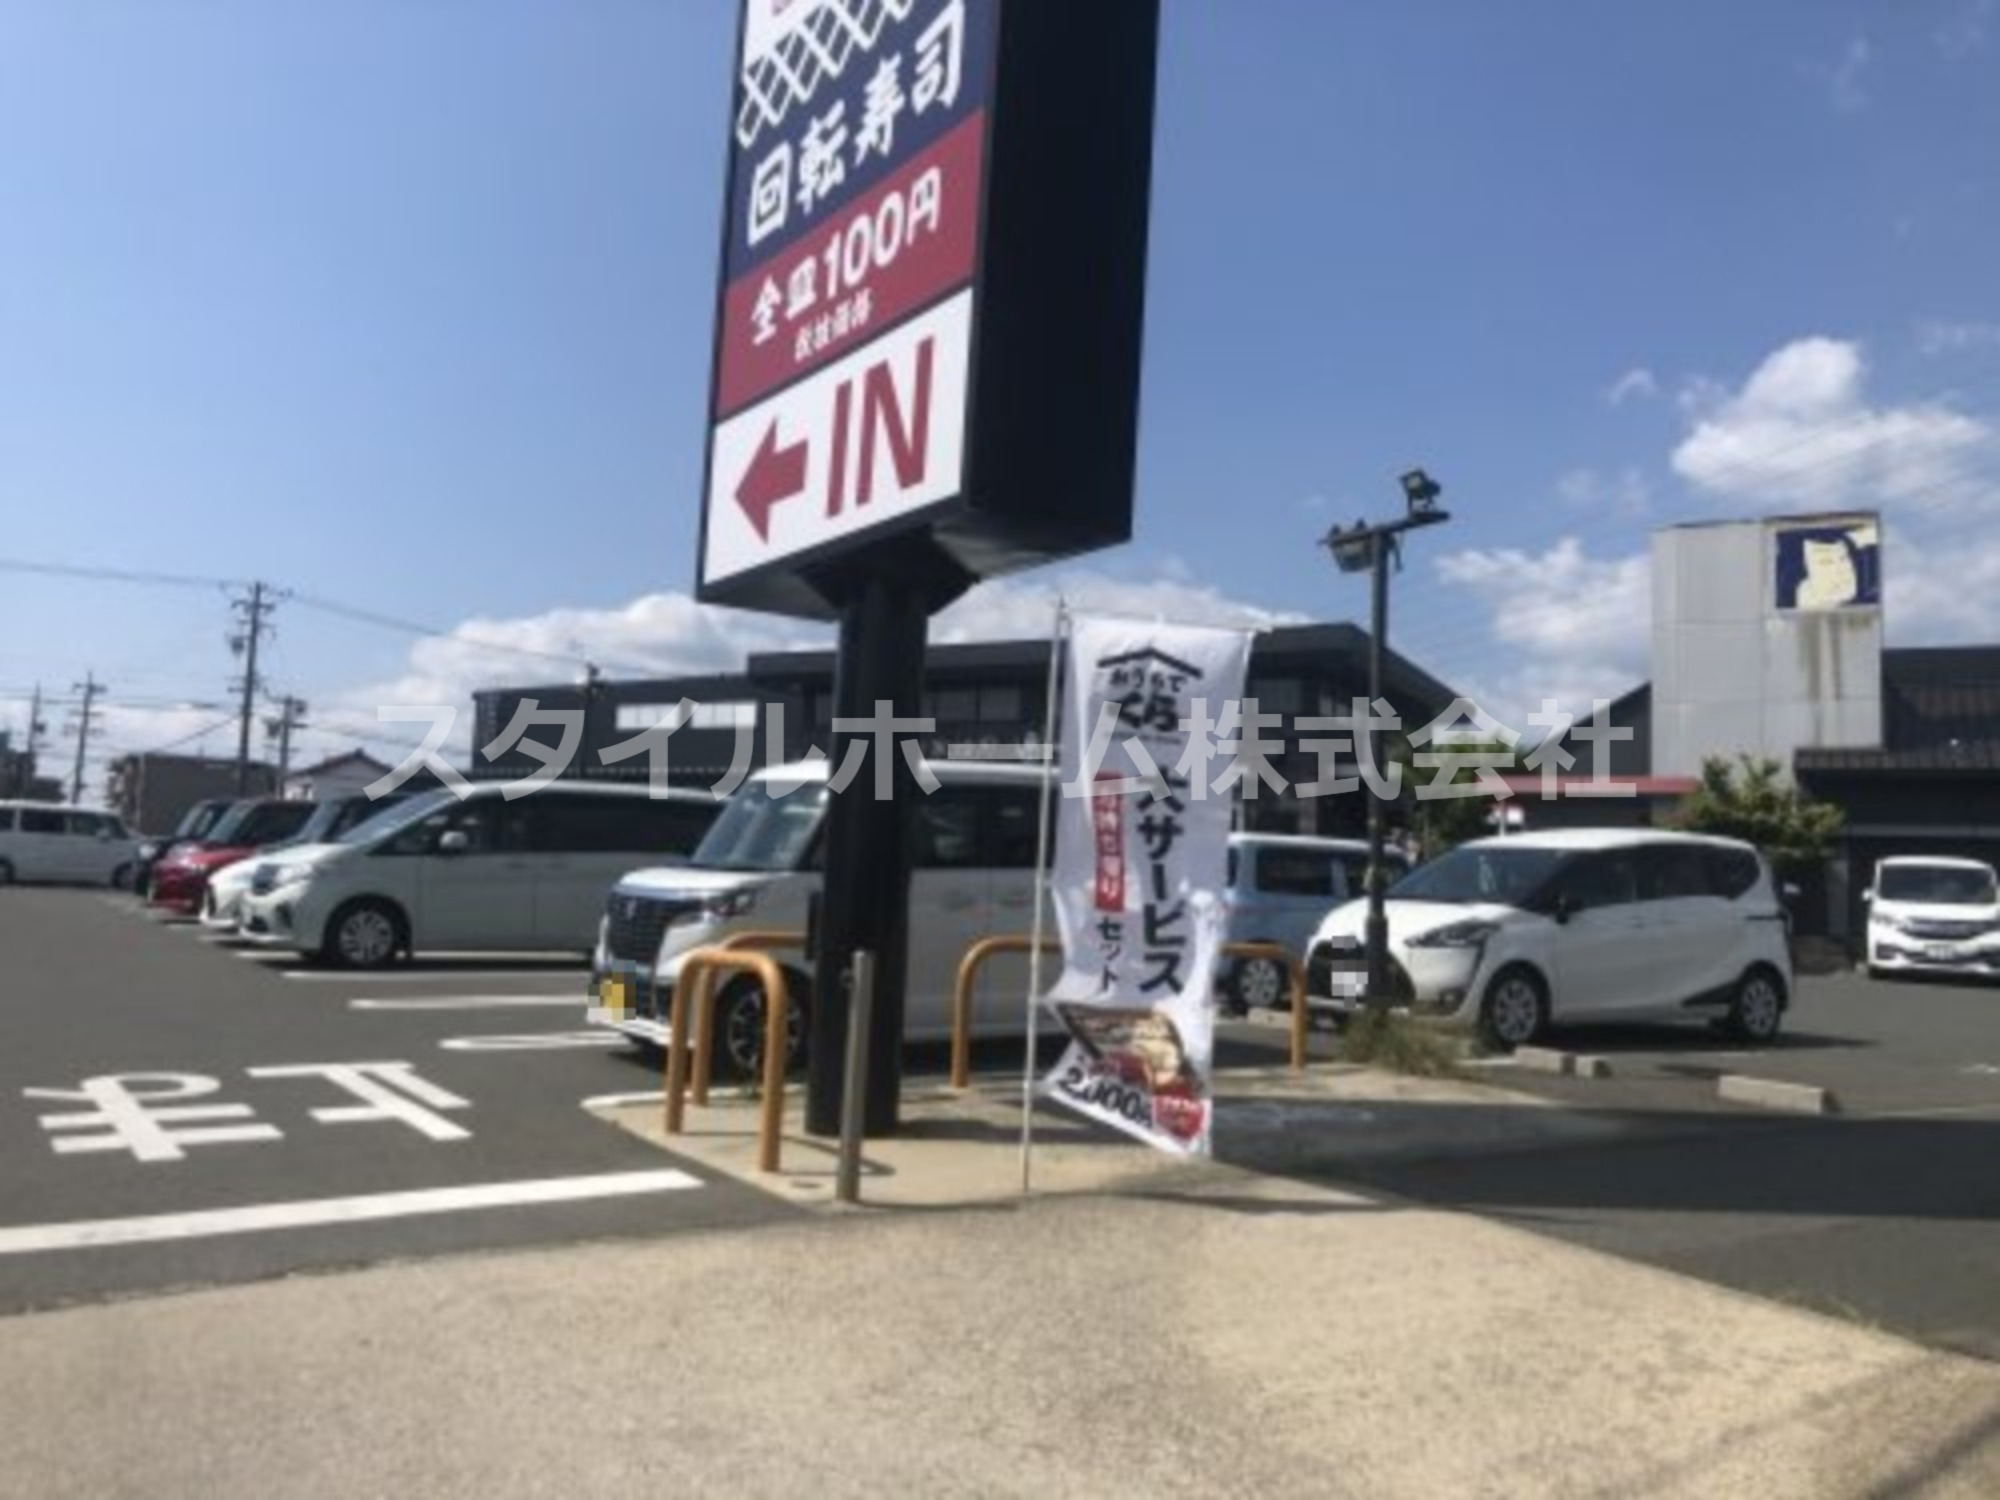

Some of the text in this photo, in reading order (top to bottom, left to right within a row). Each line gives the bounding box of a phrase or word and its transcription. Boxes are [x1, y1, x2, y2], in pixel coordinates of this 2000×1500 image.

[748, 0, 965, 245] 回転寿司
[826, 335, 934, 518] IN
